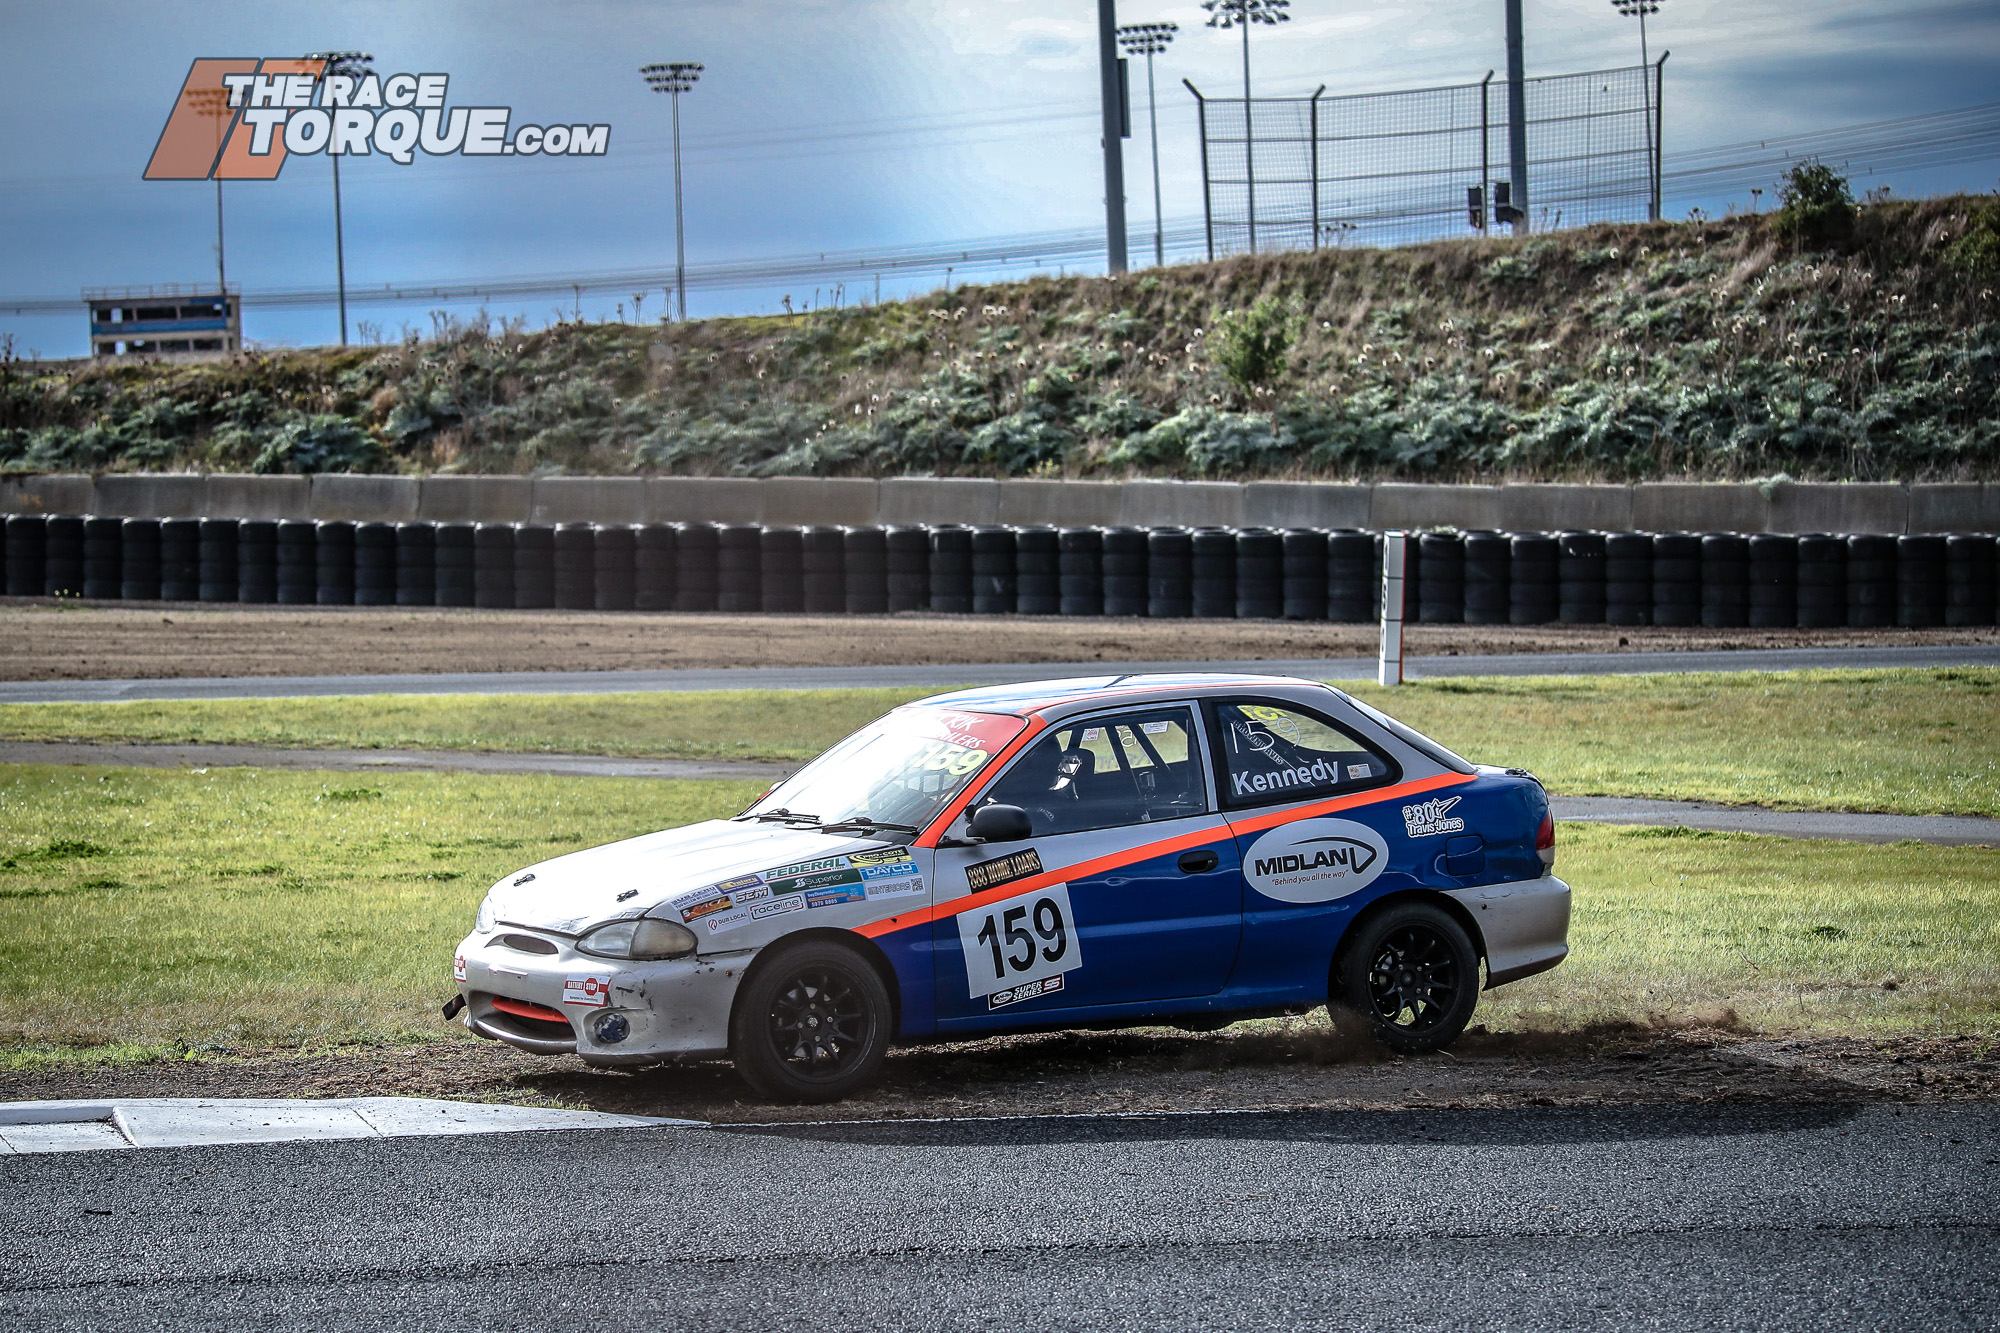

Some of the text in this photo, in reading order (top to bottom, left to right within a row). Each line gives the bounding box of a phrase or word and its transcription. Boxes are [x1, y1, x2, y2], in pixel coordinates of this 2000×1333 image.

[912, 743, 988, 776] 159
[1232, 758, 1339, 795] Kennedy
[1408, 820, 1462, 835] Travis Jones
[765, 858, 846, 880] FEDERAL
[866, 863, 913, 876] DAYCO
[968, 850, 1042, 889] 888 HOME LOANS
[804, 873, 844, 886] Superior
[1298, 875, 1311, 886] you
[1312, 873, 1320, 881] all
[1321, 872, 1332, 881] the
[754, 898, 800, 915] raceline
[731, 912, 748, 922] LOCAL
[977, 897, 1068, 979] 159
[586, 982, 597, 991] STOP
[1014, 980, 1043, 994] SUPER
[1012, 987, 1043, 1001] SERIES
